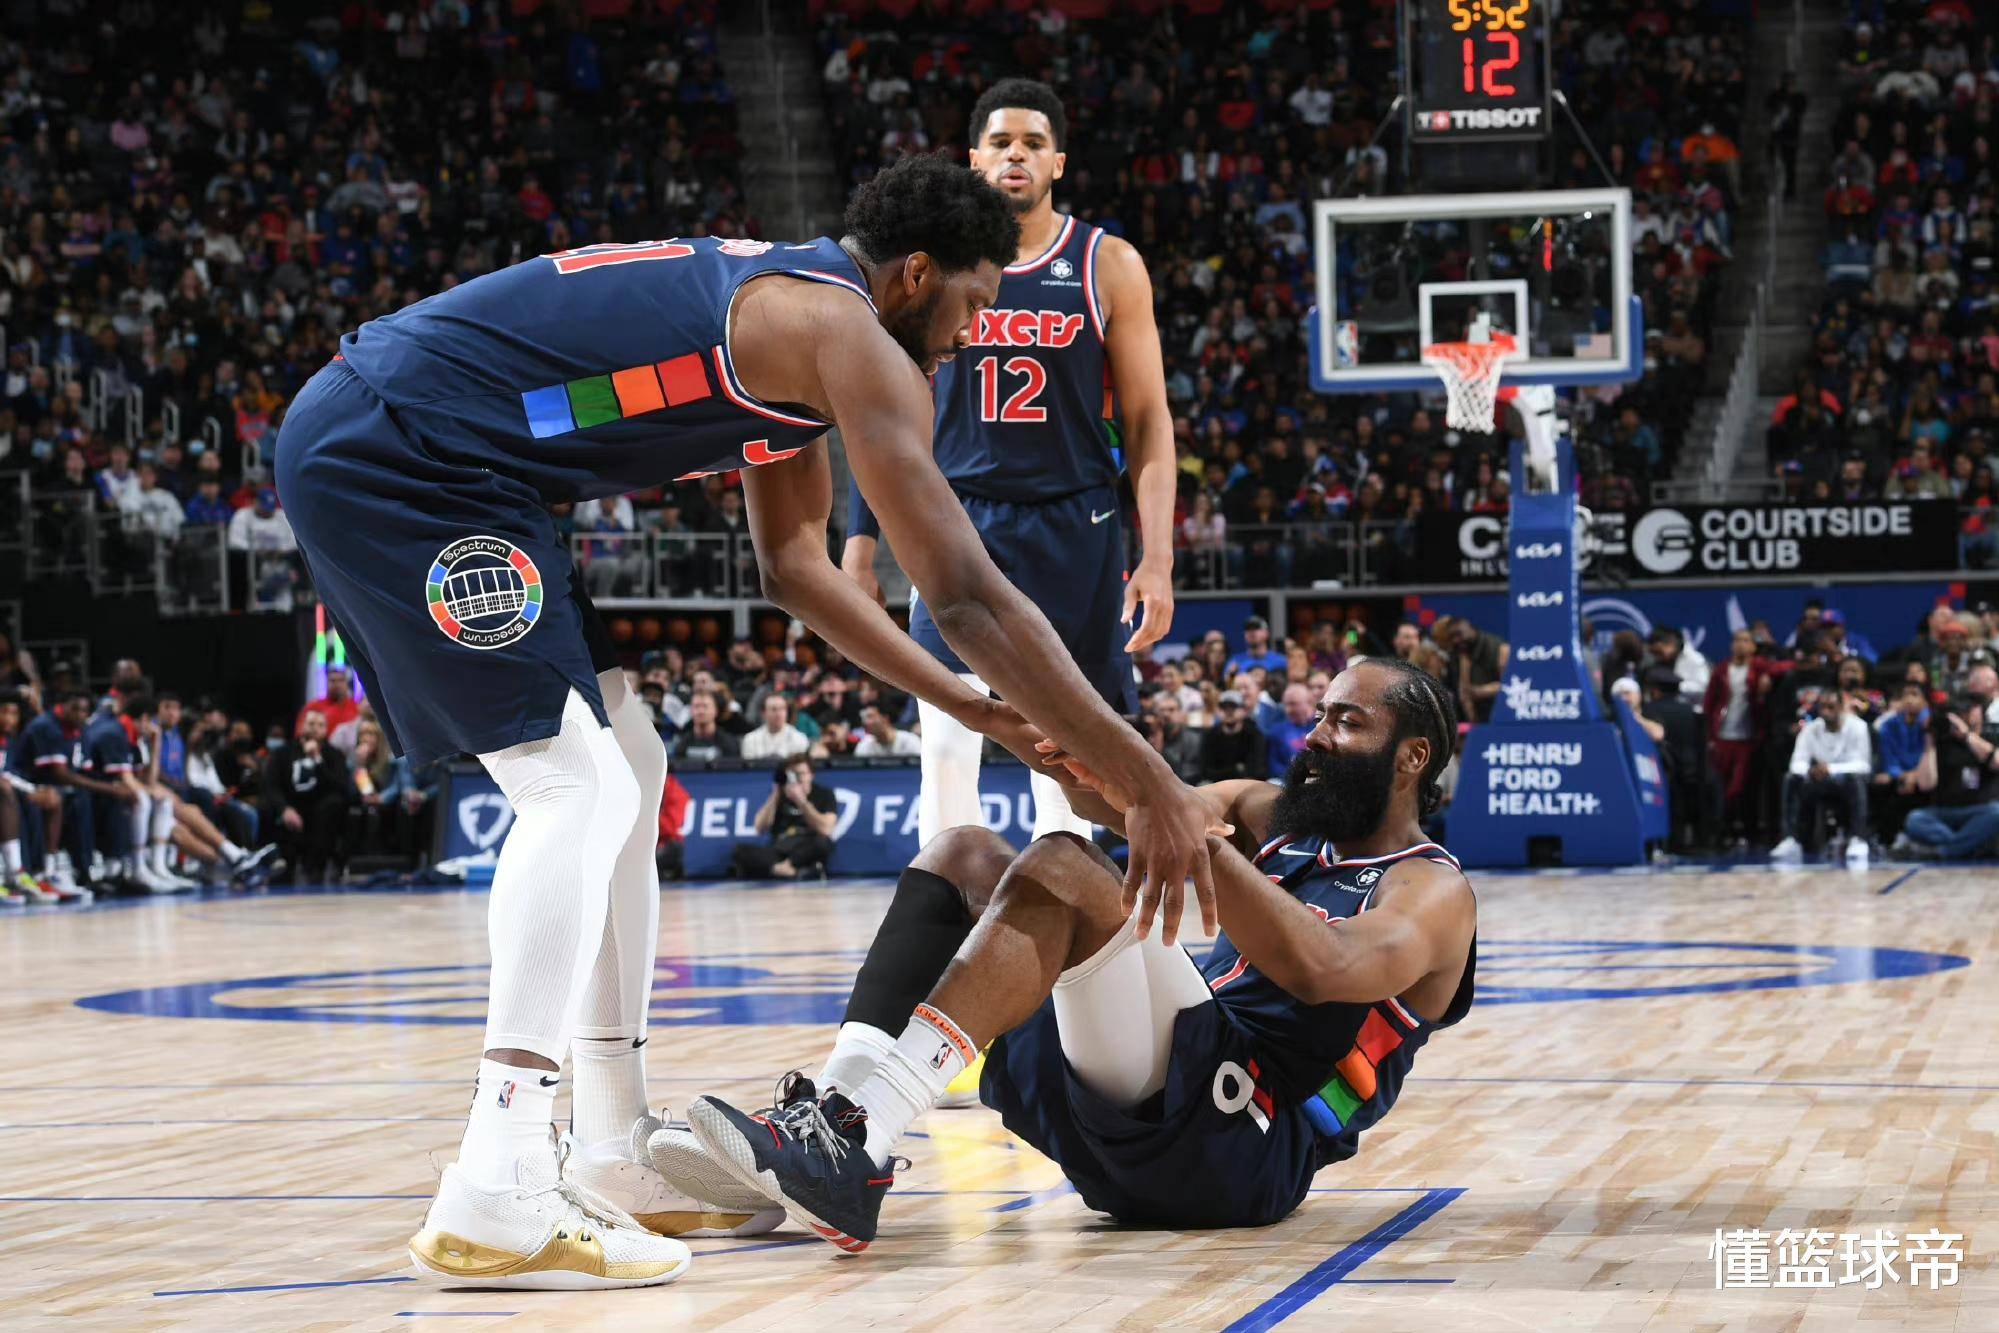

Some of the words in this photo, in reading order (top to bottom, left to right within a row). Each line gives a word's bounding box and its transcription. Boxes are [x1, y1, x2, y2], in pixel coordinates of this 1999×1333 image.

[1448, 0, 1529, 31] 5:52
[1462, 31, 1519, 97] 12
[1451, 107, 1542, 129] TISSOT
[974, 356, 1047, 422] 12
[1701, 505, 1912, 539] COURTSIDE
[443, 541, 506, 562] Spectrum
[1701, 540, 1800, 570] CLUB
[462, 621, 525, 643] Spectrum
[1482, 743, 1582, 766] HENRY
[1488, 768, 1561, 790] FORD
[1488, 792, 1600, 815] HEALTH
